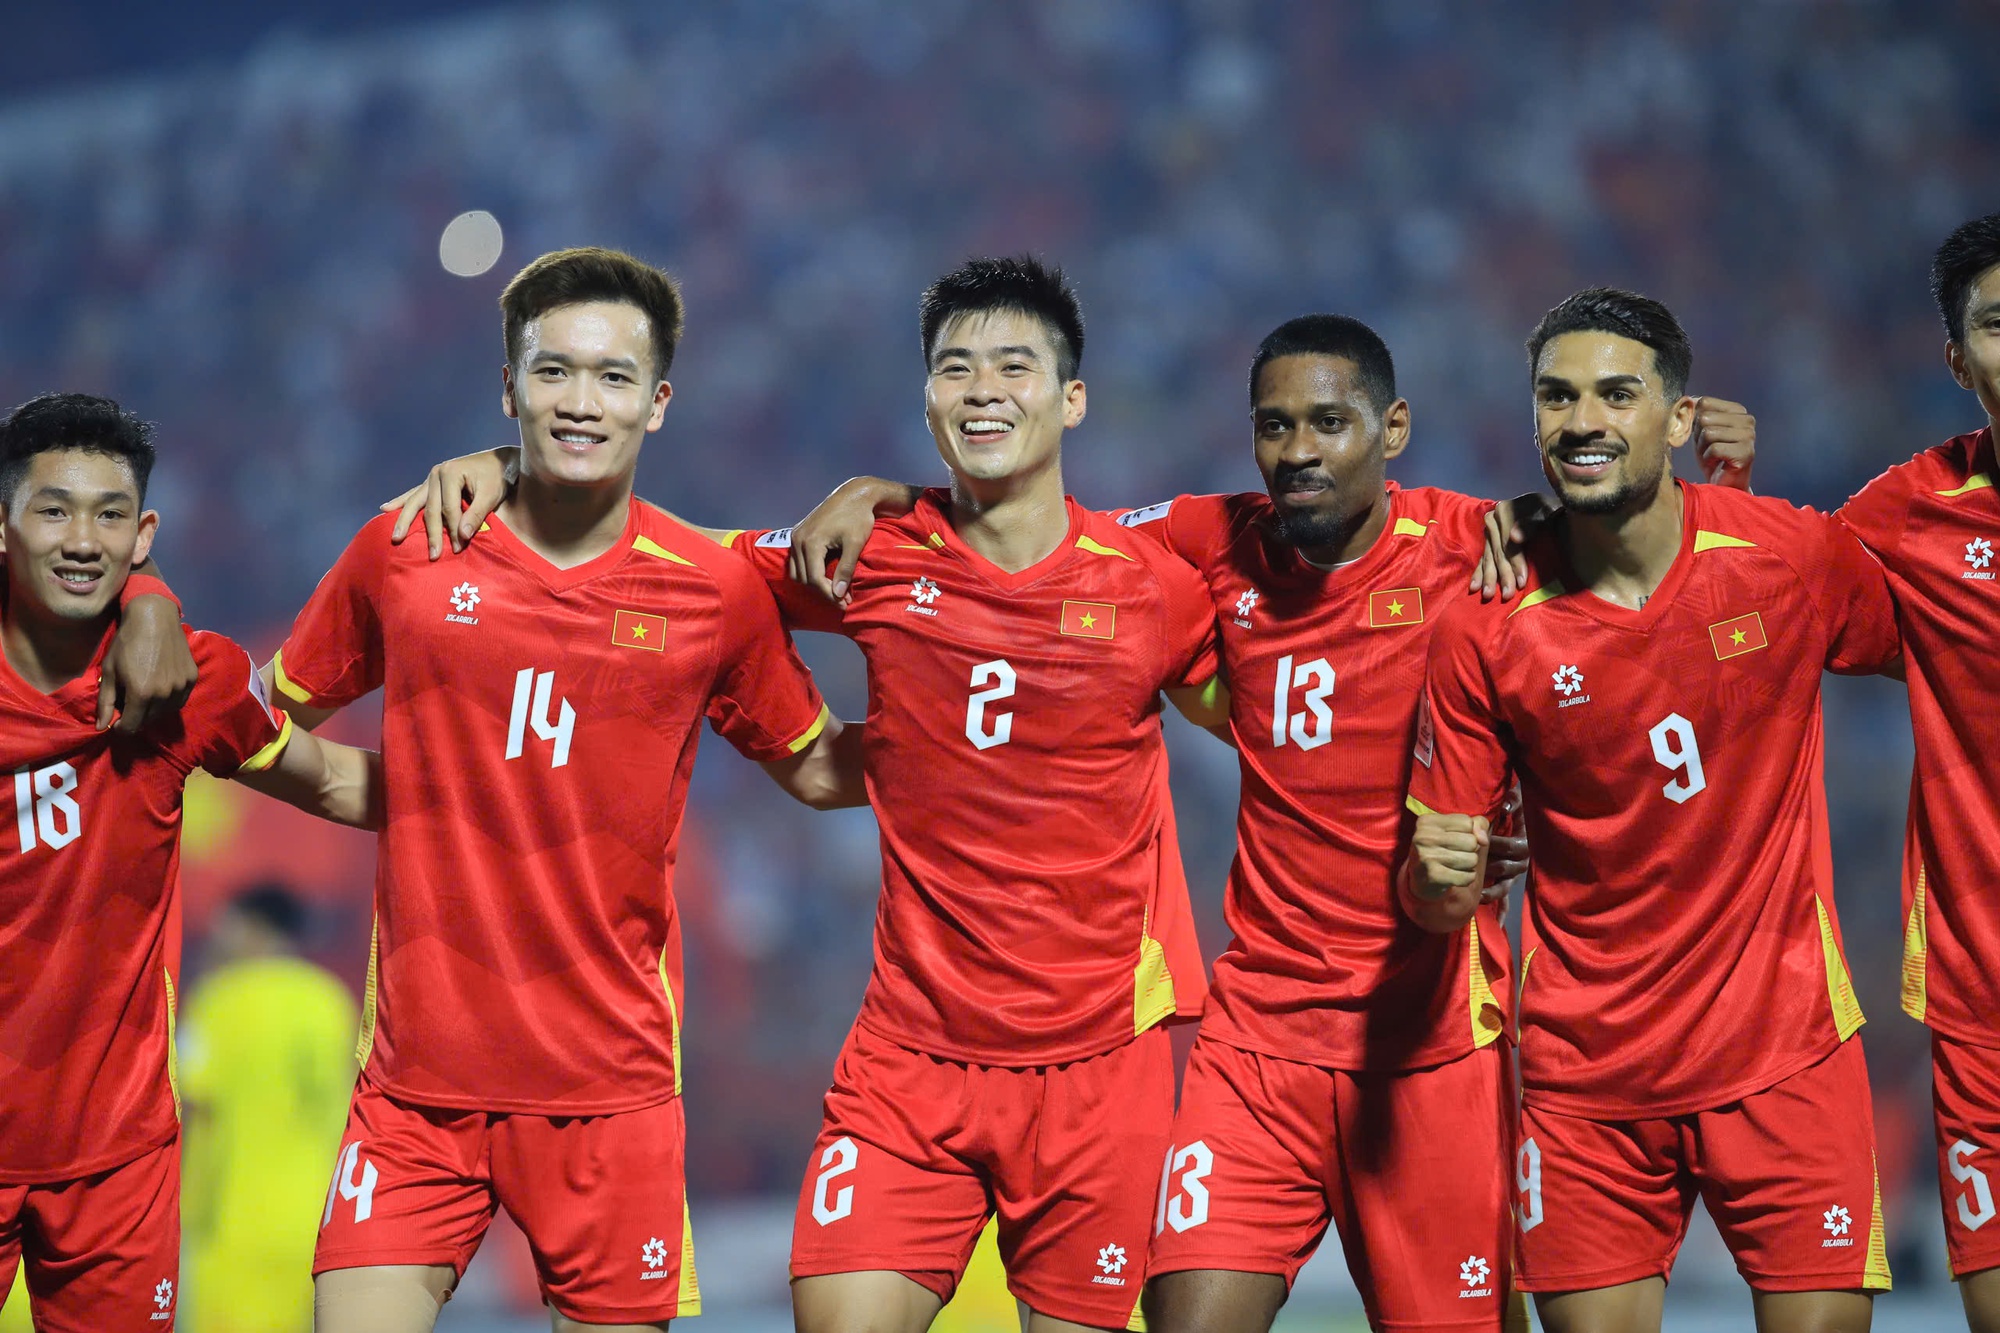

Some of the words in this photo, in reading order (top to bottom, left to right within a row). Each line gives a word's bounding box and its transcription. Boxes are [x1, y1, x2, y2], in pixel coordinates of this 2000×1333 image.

[444, 614, 478, 625] JOGARBOLA
[1961, 571, 1995, 580] JOGARBOLA
[505, 667, 576, 768] 14
[966, 659, 1017, 750] 2
[1272, 655, 1336, 751] 13
[1558, 694, 1591, 709] JOGARBOLA
[1649, 712, 1706, 804] 9
[15, 761, 81, 854] 18
[323, 1140, 379, 1228] 14
[812, 1136, 858, 1227] 2
[1157, 1140, 1214, 1236] 13
[1516, 1137, 1544, 1233] 9
[1948, 1139, 1997, 1232] 5
[640, 1270, 668, 1280] JOGARBOLA
[1092, 1276, 1125, 1286] JOGARBOLA
[1822, 1238, 1853, 1247] JOGARBOLA
[1459, 1289, 1491, 1298] JOGARBOLA
